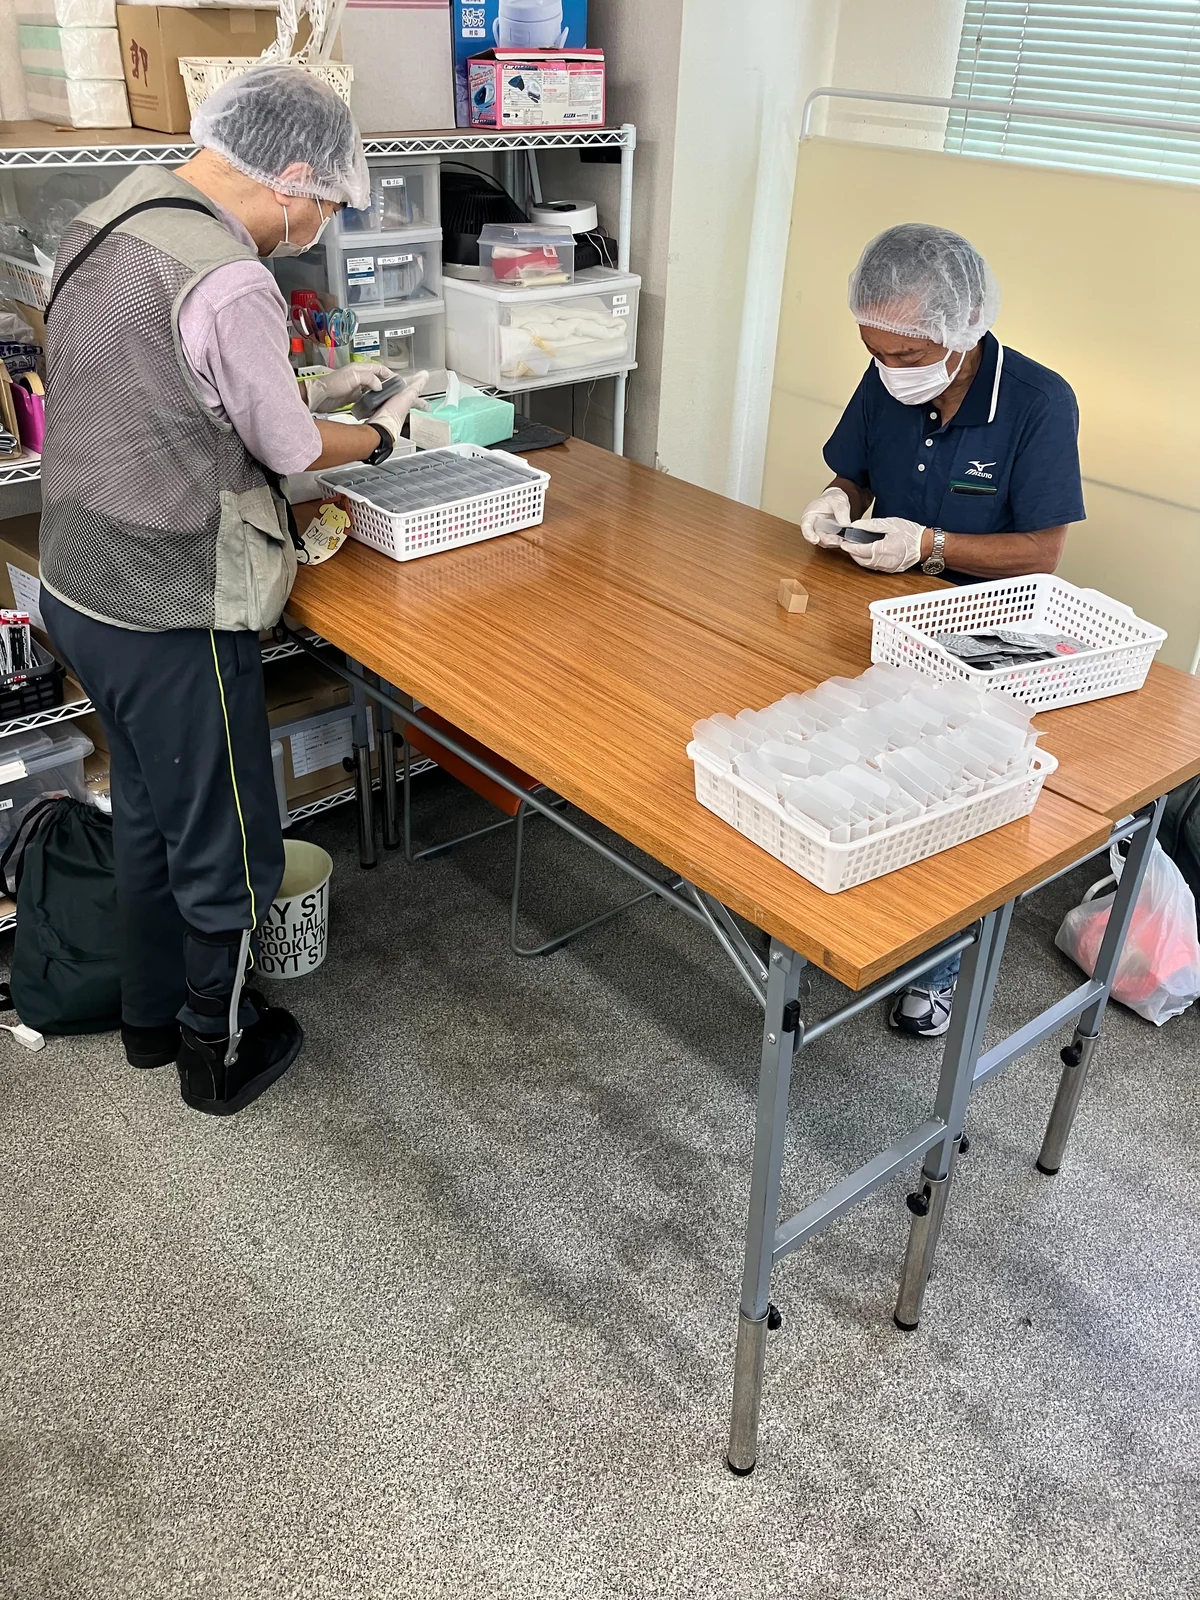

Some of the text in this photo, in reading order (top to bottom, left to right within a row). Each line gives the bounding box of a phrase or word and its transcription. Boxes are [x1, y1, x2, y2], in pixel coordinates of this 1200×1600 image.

[462, 18, 485, 27] ドリンク
[964, 468, 993, 480] MIZUNO
[301, 881, 327, 918] ST
[308, 937, 326, 965] ST
